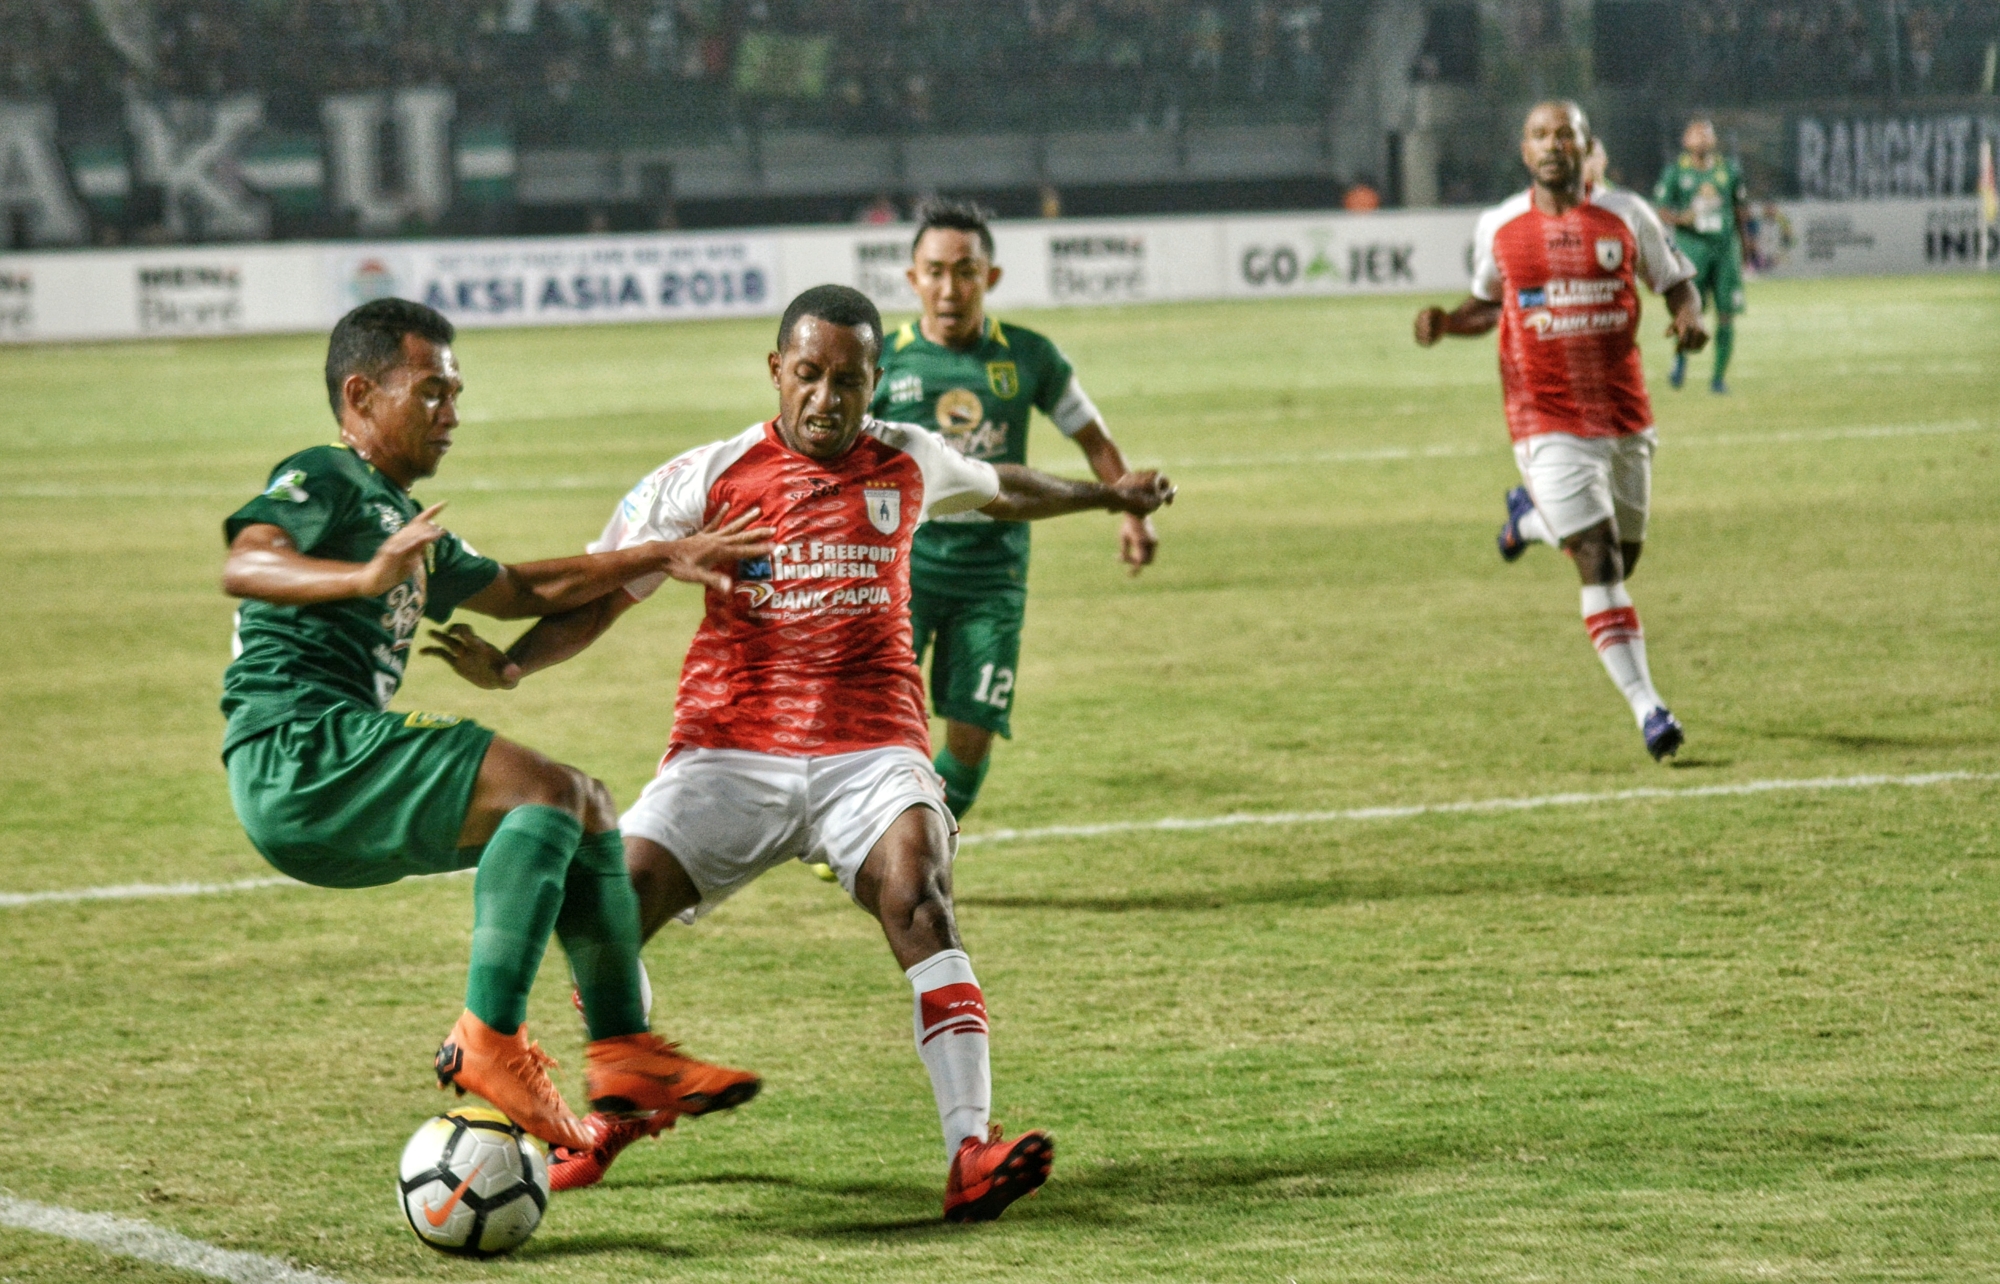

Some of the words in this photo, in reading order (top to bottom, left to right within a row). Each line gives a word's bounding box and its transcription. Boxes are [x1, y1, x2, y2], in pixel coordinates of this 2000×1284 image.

[1242, 244, 1298, 286] GO
[1348, 243, 1414, 284] JEK
[424, 276, 526, 311] AKSI
[538, 274, 646, 309] ASIA
[660, 268, 767, 305] 2018
[774, 543, 803, 562] PT
[810, 541, 897, 562] FREEPORT
[775, 561, 878, 581] INDONESIA
[770, 590, 826, 609] BANK
[832, 586, 891, 605] PAPUA
[973, 662, 1014, 709] 12
